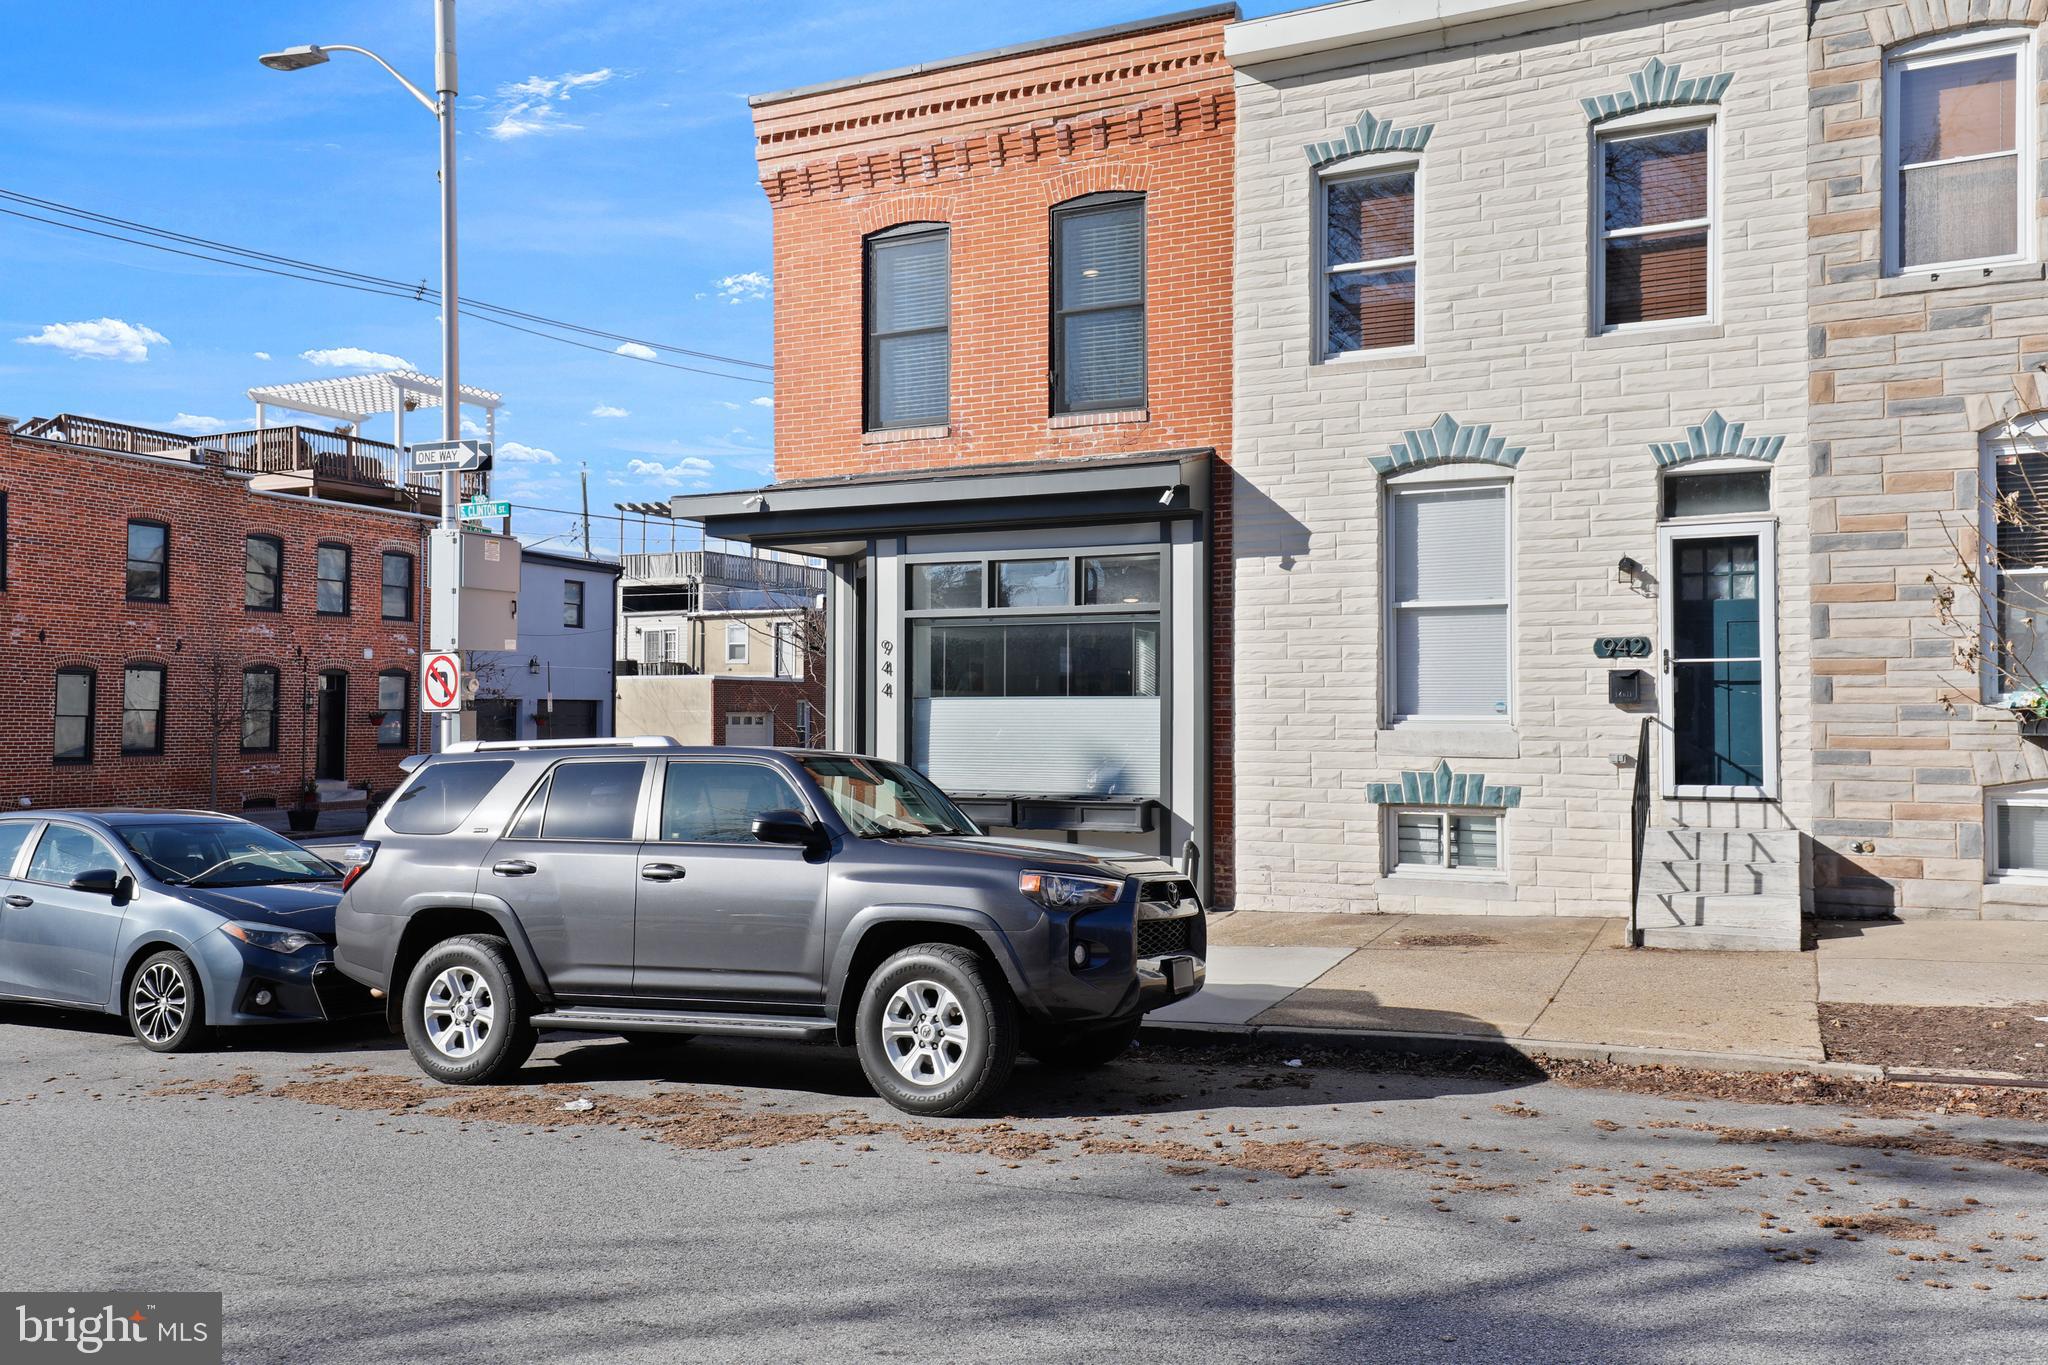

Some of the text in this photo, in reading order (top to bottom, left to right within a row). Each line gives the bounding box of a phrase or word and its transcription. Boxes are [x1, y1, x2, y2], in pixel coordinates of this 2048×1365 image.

[418, 450, 459, 463] ONE WAY
[468, 504, 497, 517] CLINTON
[1602, 638, 1643, 657] 942
[881, 640, 893, 698] 944
